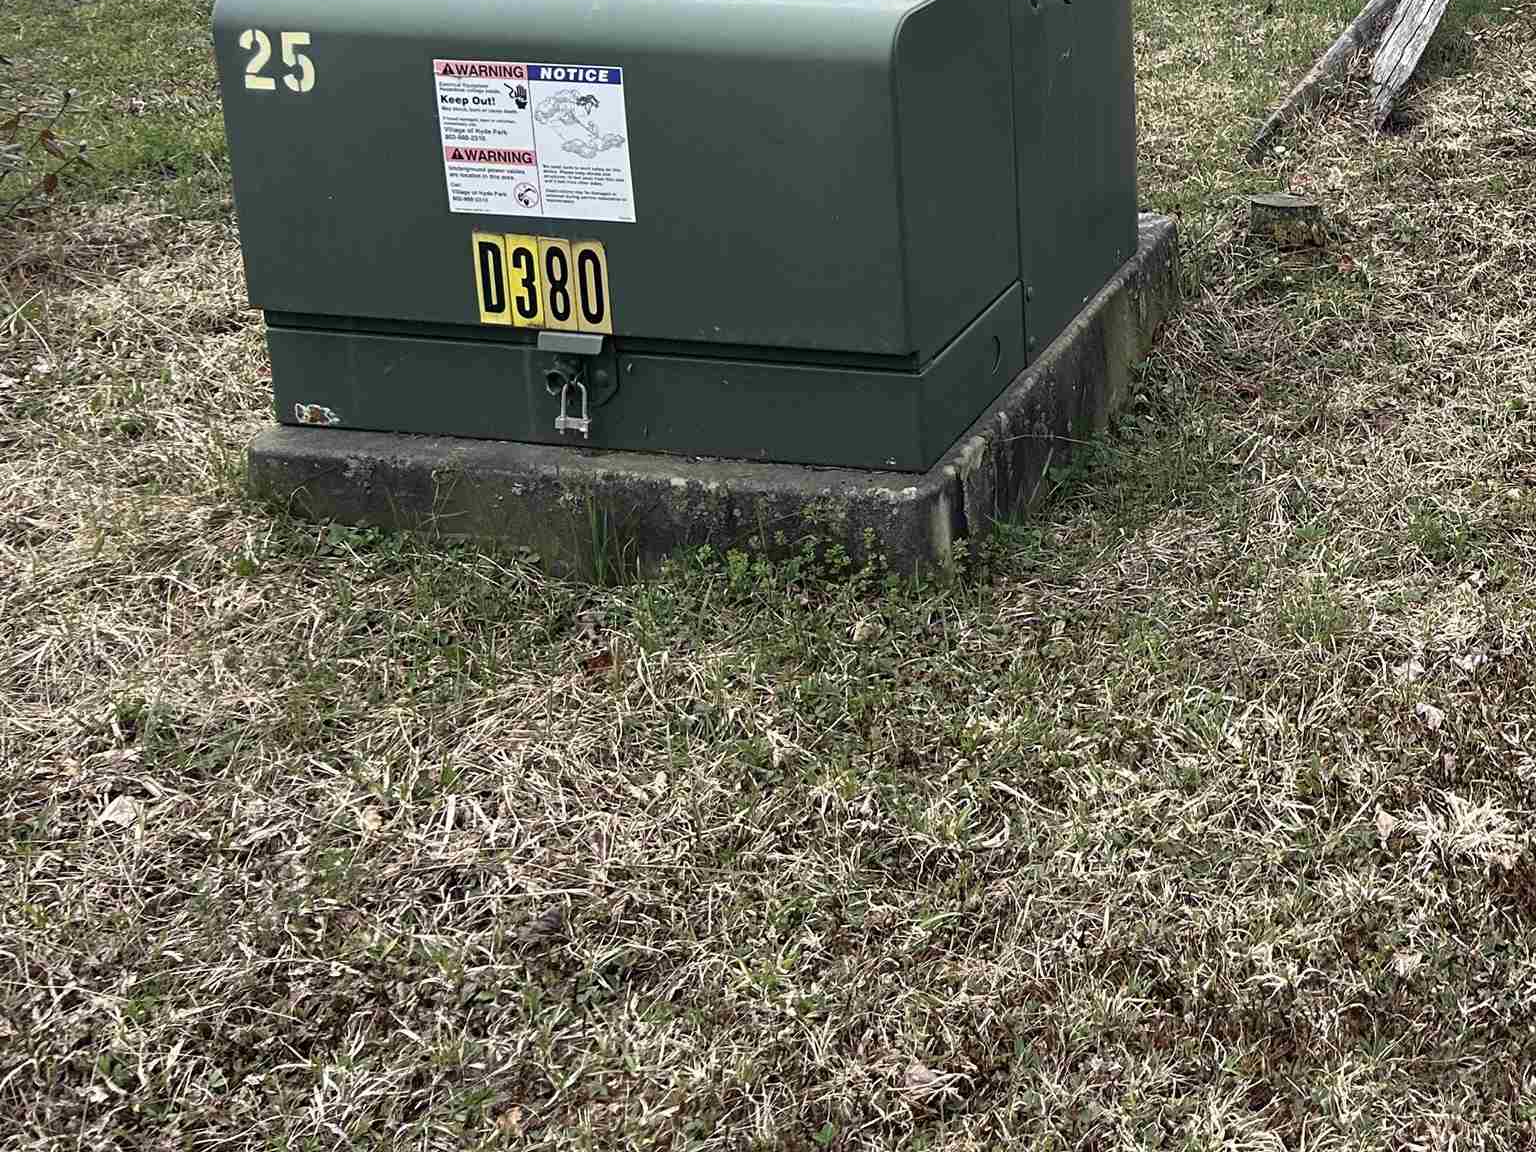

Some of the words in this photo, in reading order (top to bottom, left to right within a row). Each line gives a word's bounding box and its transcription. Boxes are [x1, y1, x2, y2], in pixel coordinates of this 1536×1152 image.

[238, 29, 316, 92] 25
[455, 63, 524, 78] WARNING
[540, 67, 609, 82] NOTICE
[440, 95, 469, 106] Keep
[472, 96, 496, 106] Out!
[464, 149, 533, 164] WARNING
[478, 240, 606, 325] D380
